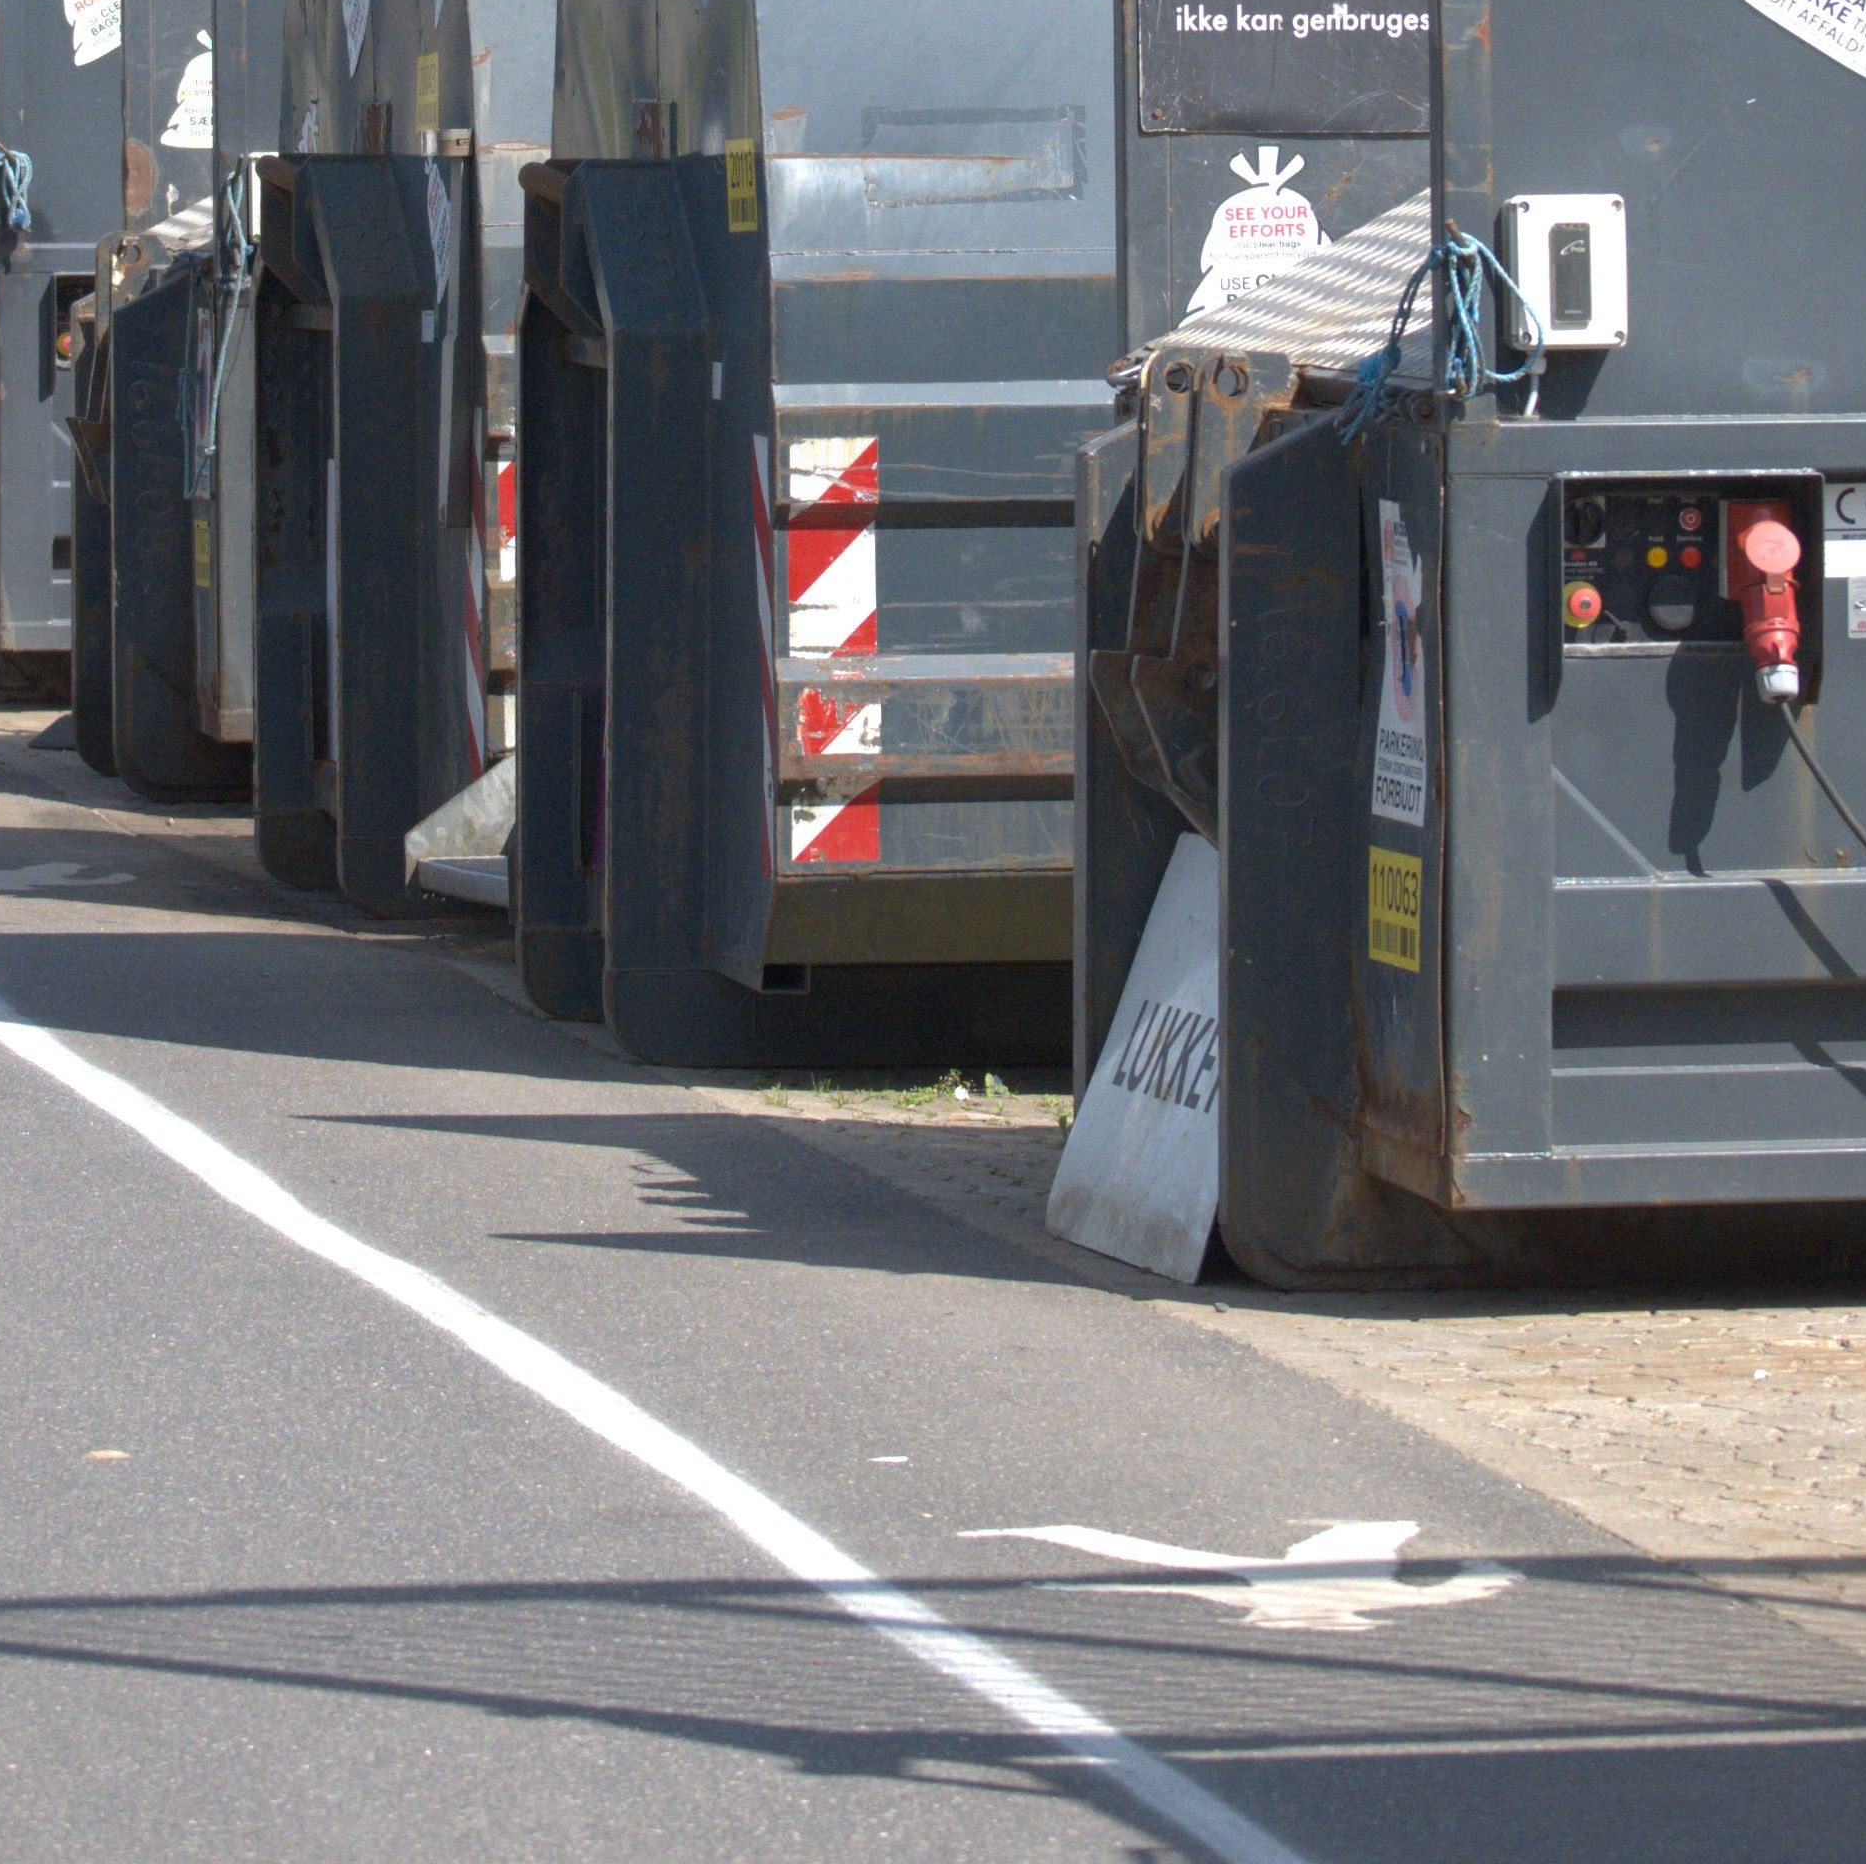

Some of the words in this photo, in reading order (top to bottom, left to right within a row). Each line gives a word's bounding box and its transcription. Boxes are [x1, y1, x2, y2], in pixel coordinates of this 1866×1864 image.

[90, 15, 119, 36] BAGS
[1176, 4, 1228, 32] ikke
[1236, 4, 1283, 32] kan
[1292, 3, 1430, 39] genbruges
[1797, 8, 1866, 55] AFFALD!
[189, 116, 213, 127] SÆ
[1225, 208, 1255, 222] SEE
[1260, 205, 1309, 220] YOUR
[1229, 223, 1307, 239] EFFORTS
[1220, 276, 1251, 291] USE
[1374, 775, 1422, 814] FORBUDT
[1372, 862, 1418, 917] 110063
